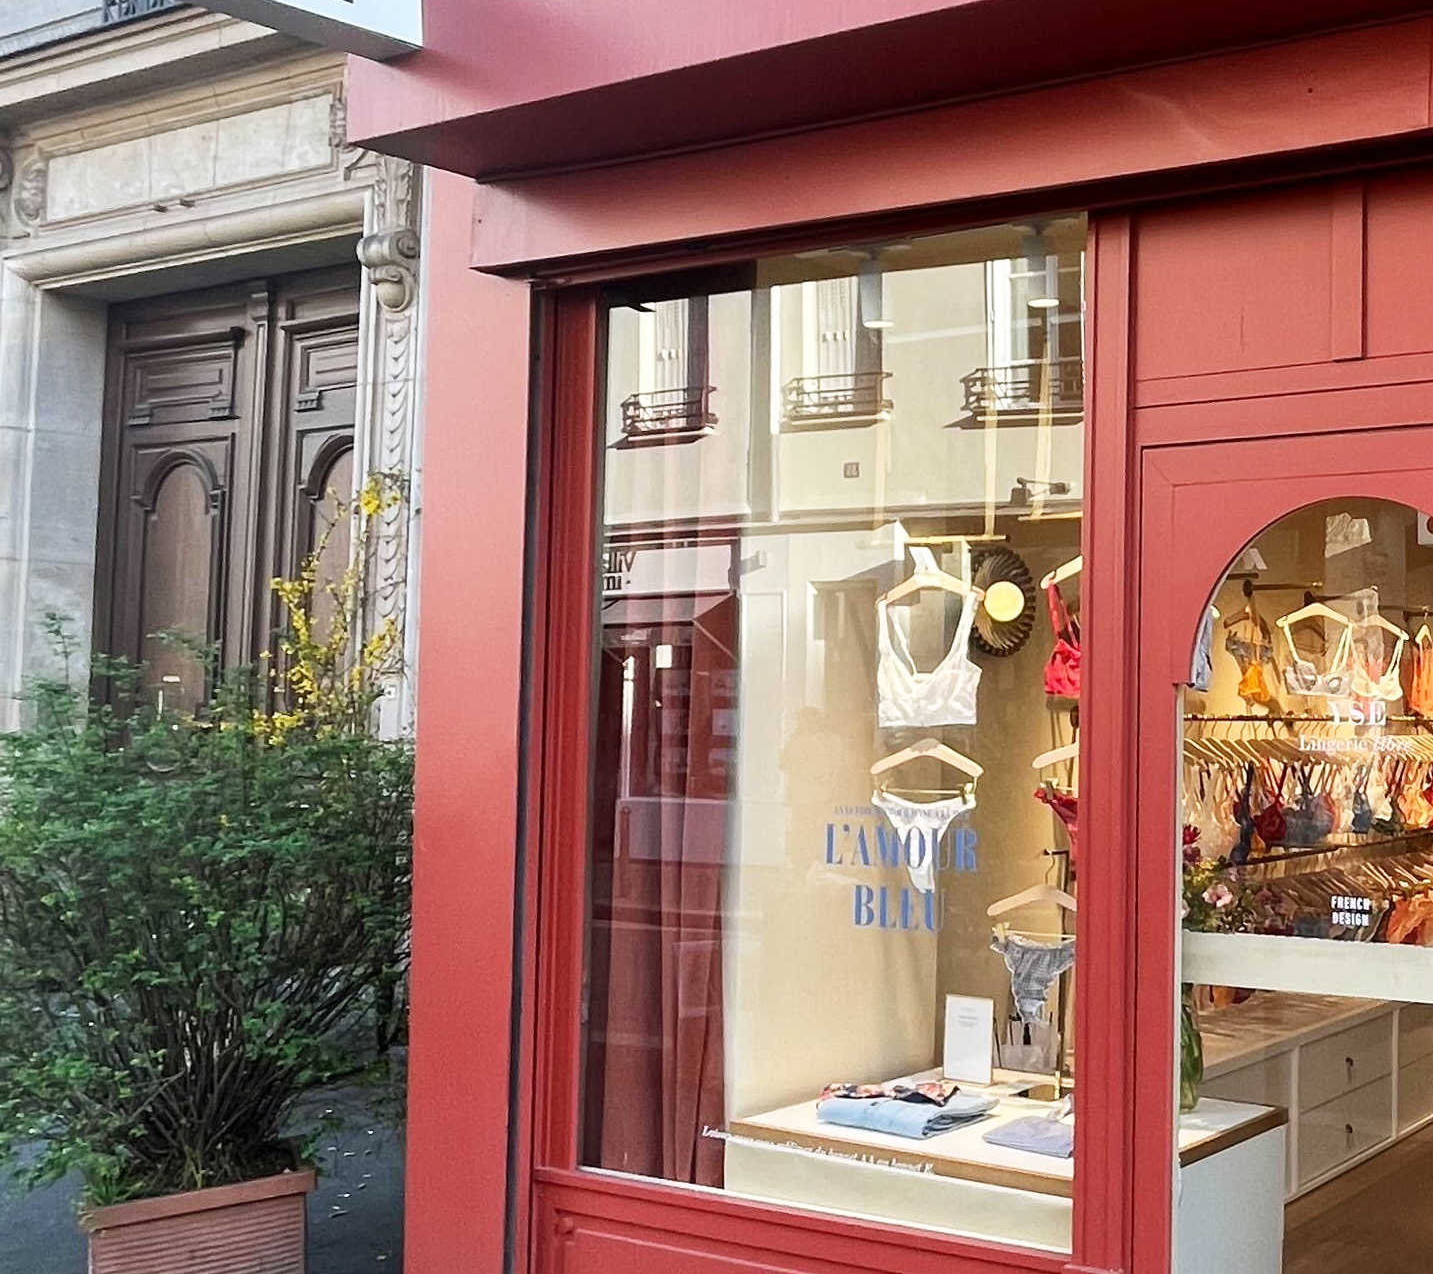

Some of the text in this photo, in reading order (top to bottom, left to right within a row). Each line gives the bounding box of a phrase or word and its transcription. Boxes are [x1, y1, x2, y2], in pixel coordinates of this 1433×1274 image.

[1299, 734, 1367, 756] Lingerie
[826, 822, 979, 873] L'AMOUR
[854, 884, 948, 932] BLEU
[1330, 895, 1371, 911] FRENCH
[1331, 911, 1370, 927] DESIGN
